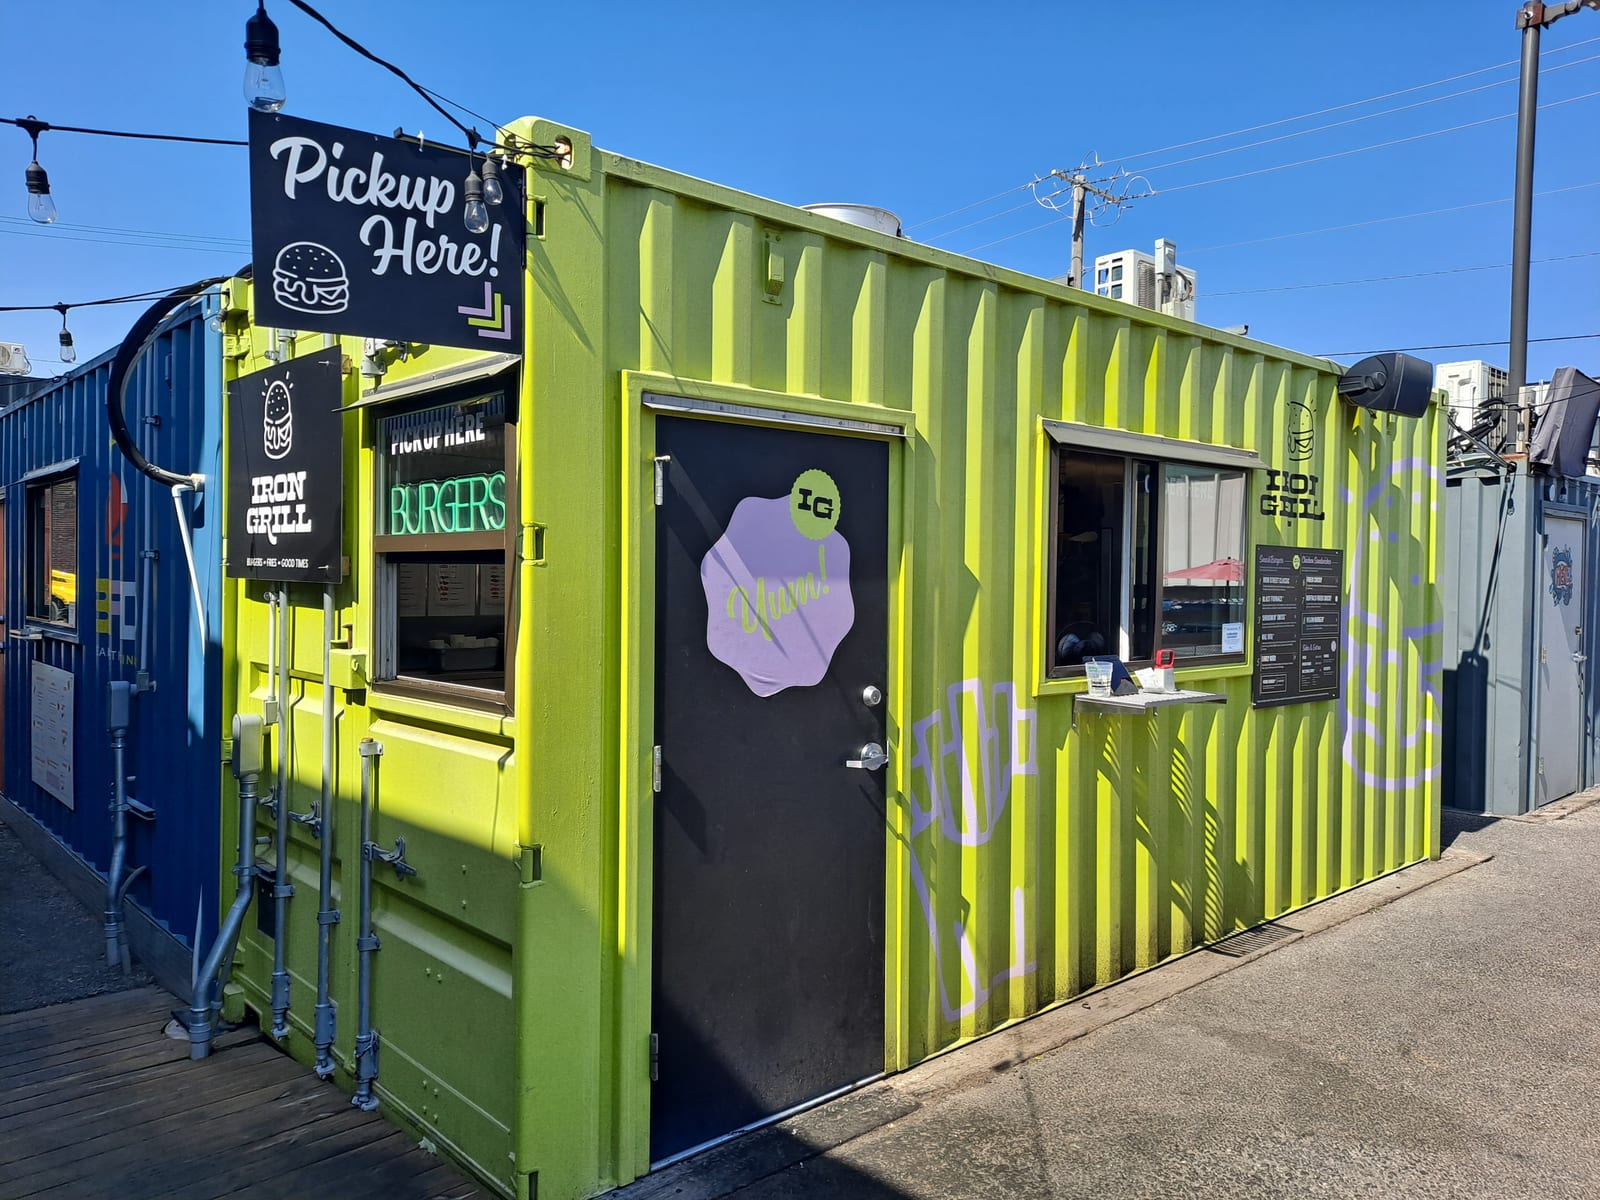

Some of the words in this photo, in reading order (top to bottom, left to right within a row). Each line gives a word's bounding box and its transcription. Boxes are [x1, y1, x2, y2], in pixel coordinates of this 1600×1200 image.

[270, 136, 455, 228] Pickup
[359, 214, 502, 277] Here!
[444, 411, 486, 447] HERE
[251, 471, 307, 504] IRON
[391, 472, 506, 536] BURGERS
[798, 488, 834, 520] IG
[247, 504, 312, 545] GRILL
[280, 558, 296, 569] GOOD
[295, 558, 309, 569] TIMES
[727, 545, 829, 641] Yum!
